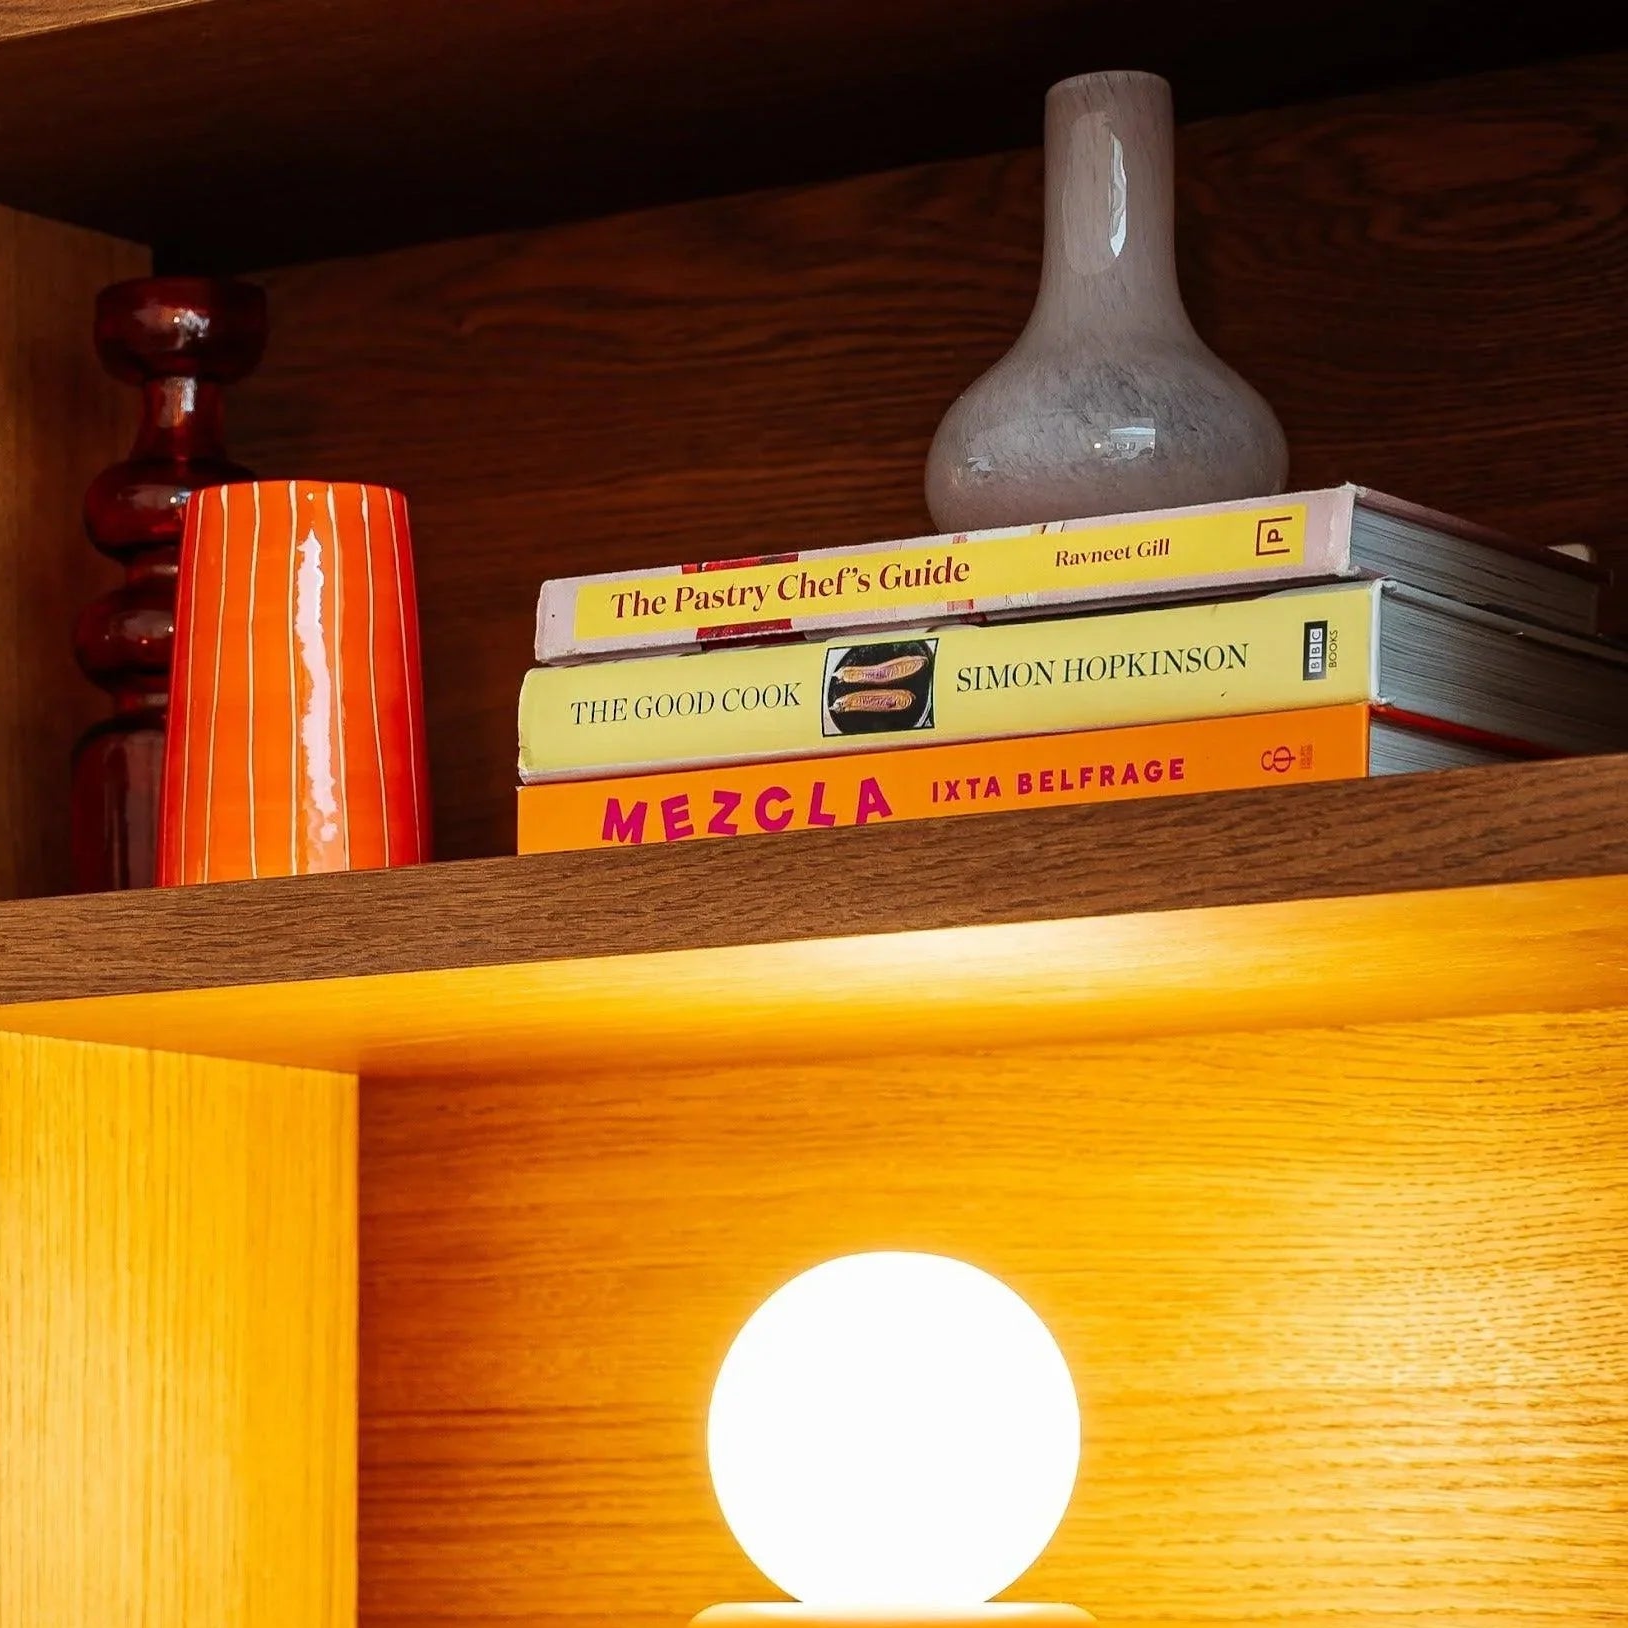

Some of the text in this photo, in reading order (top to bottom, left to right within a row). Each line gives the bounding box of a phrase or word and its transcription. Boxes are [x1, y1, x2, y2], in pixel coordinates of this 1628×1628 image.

[1055, 538, 1171, 568] Ravneet Gill
[611, 591, 667, 619] The
[674, 582, 772, 613] Pastry
[879, 556, 970, 590] Guide
[956, 643, 1250, 693] SIMON HOPKINSON
[1309, 629, 1323, 672] BBC
[1328, 629, 1339, 668] BOOKS
[570, 682, 803, 725] THE GOOD COOK
[932, 758, 1185, 803] IXTA BELFRAGE
[602, 776, 893, 844] MEZCLA
